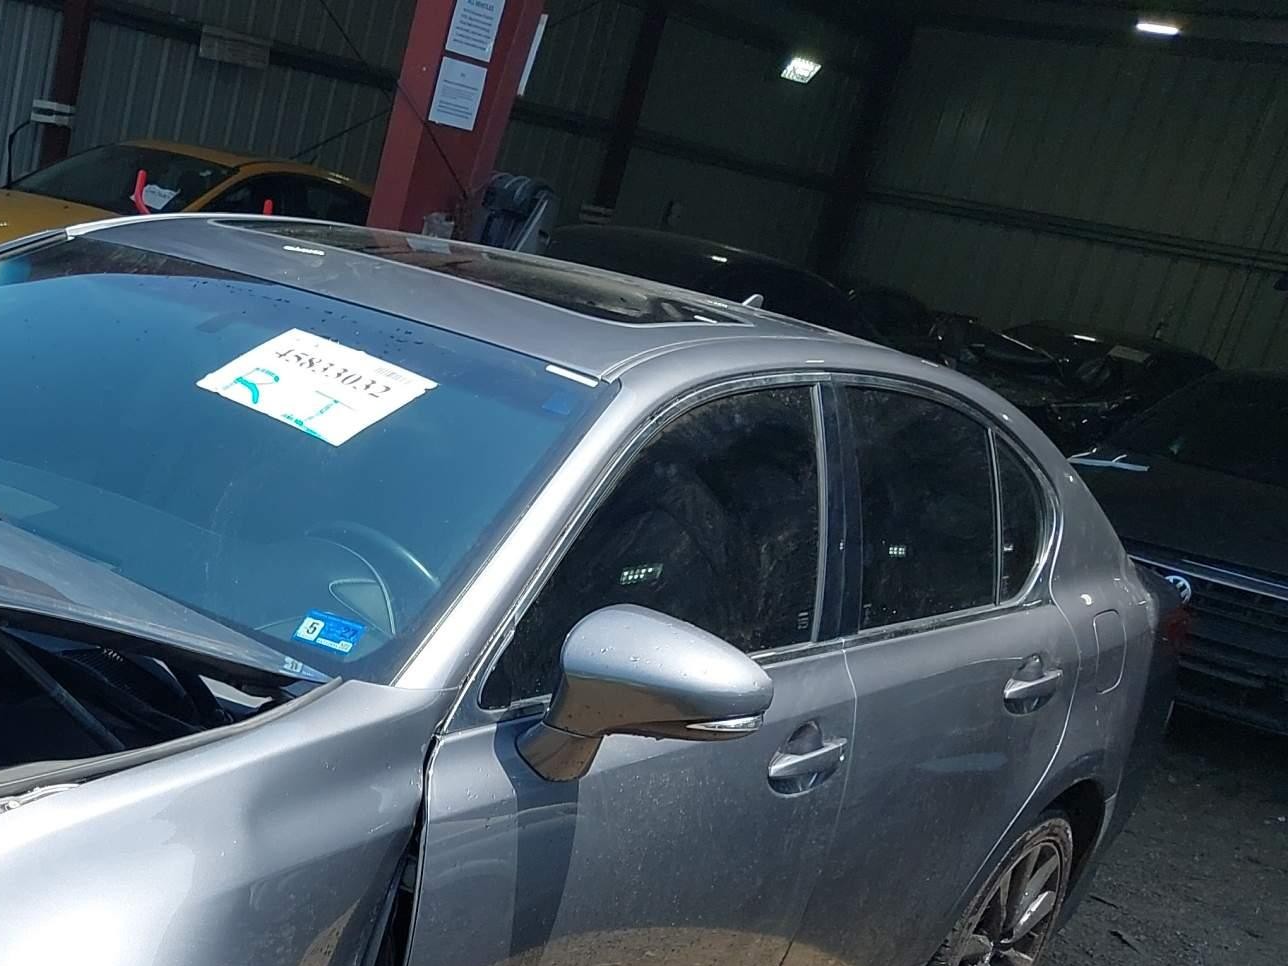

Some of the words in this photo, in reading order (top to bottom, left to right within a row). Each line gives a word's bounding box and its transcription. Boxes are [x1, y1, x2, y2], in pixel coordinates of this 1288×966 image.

[222, 366, 280, 405] R
[275, 348, 392, 399] 45833032
[306, 621, 319, 635] 5
